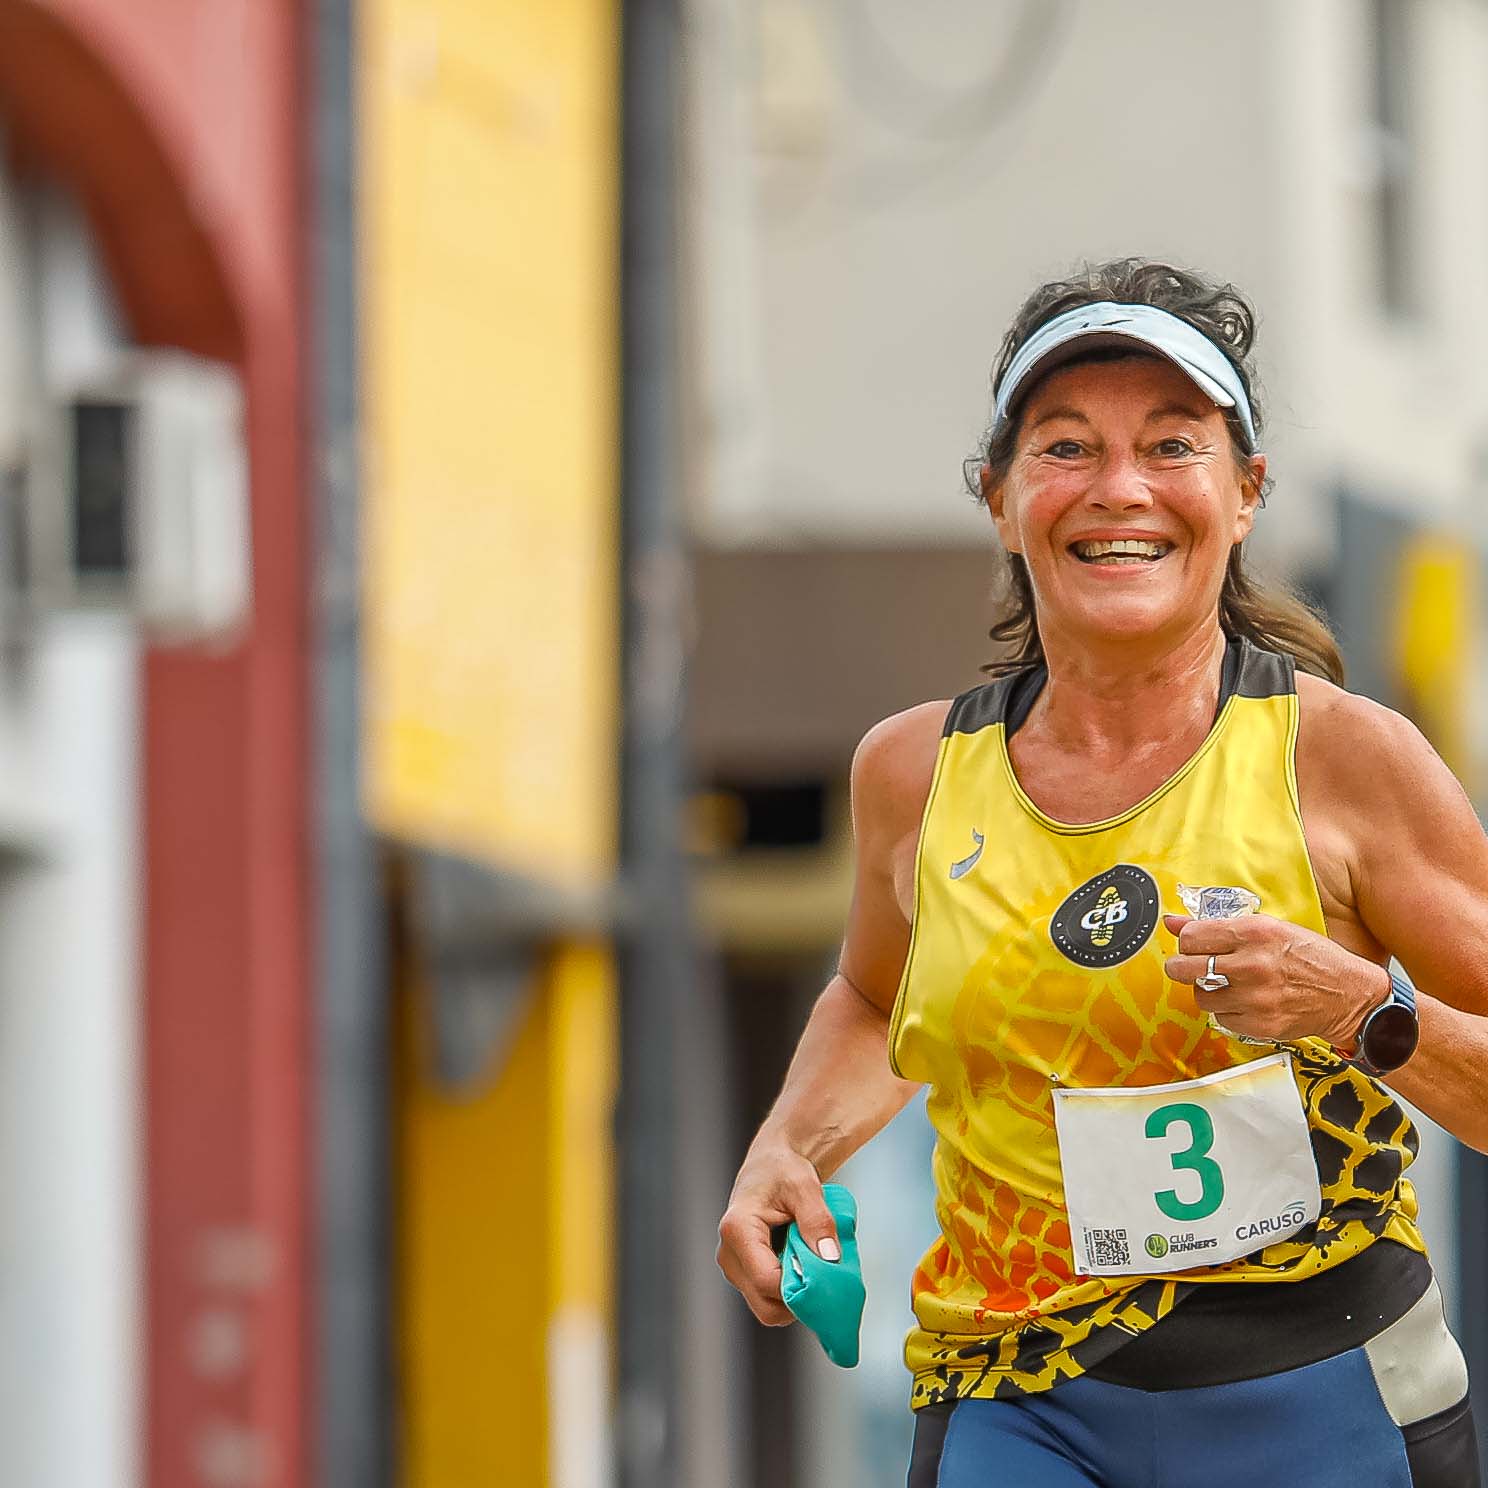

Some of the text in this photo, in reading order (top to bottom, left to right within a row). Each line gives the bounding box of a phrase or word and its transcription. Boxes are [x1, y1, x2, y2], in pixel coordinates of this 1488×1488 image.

[1080, 900, 1128, 930] CB
[1144, 1103, 1225, 1221] 3
[1169, 1233, 1195, 1244] CLUB
[1235, 1210, 1305, 1241] CARUSO
[1169, 1239, 1218, 1254] RUNNER'S
